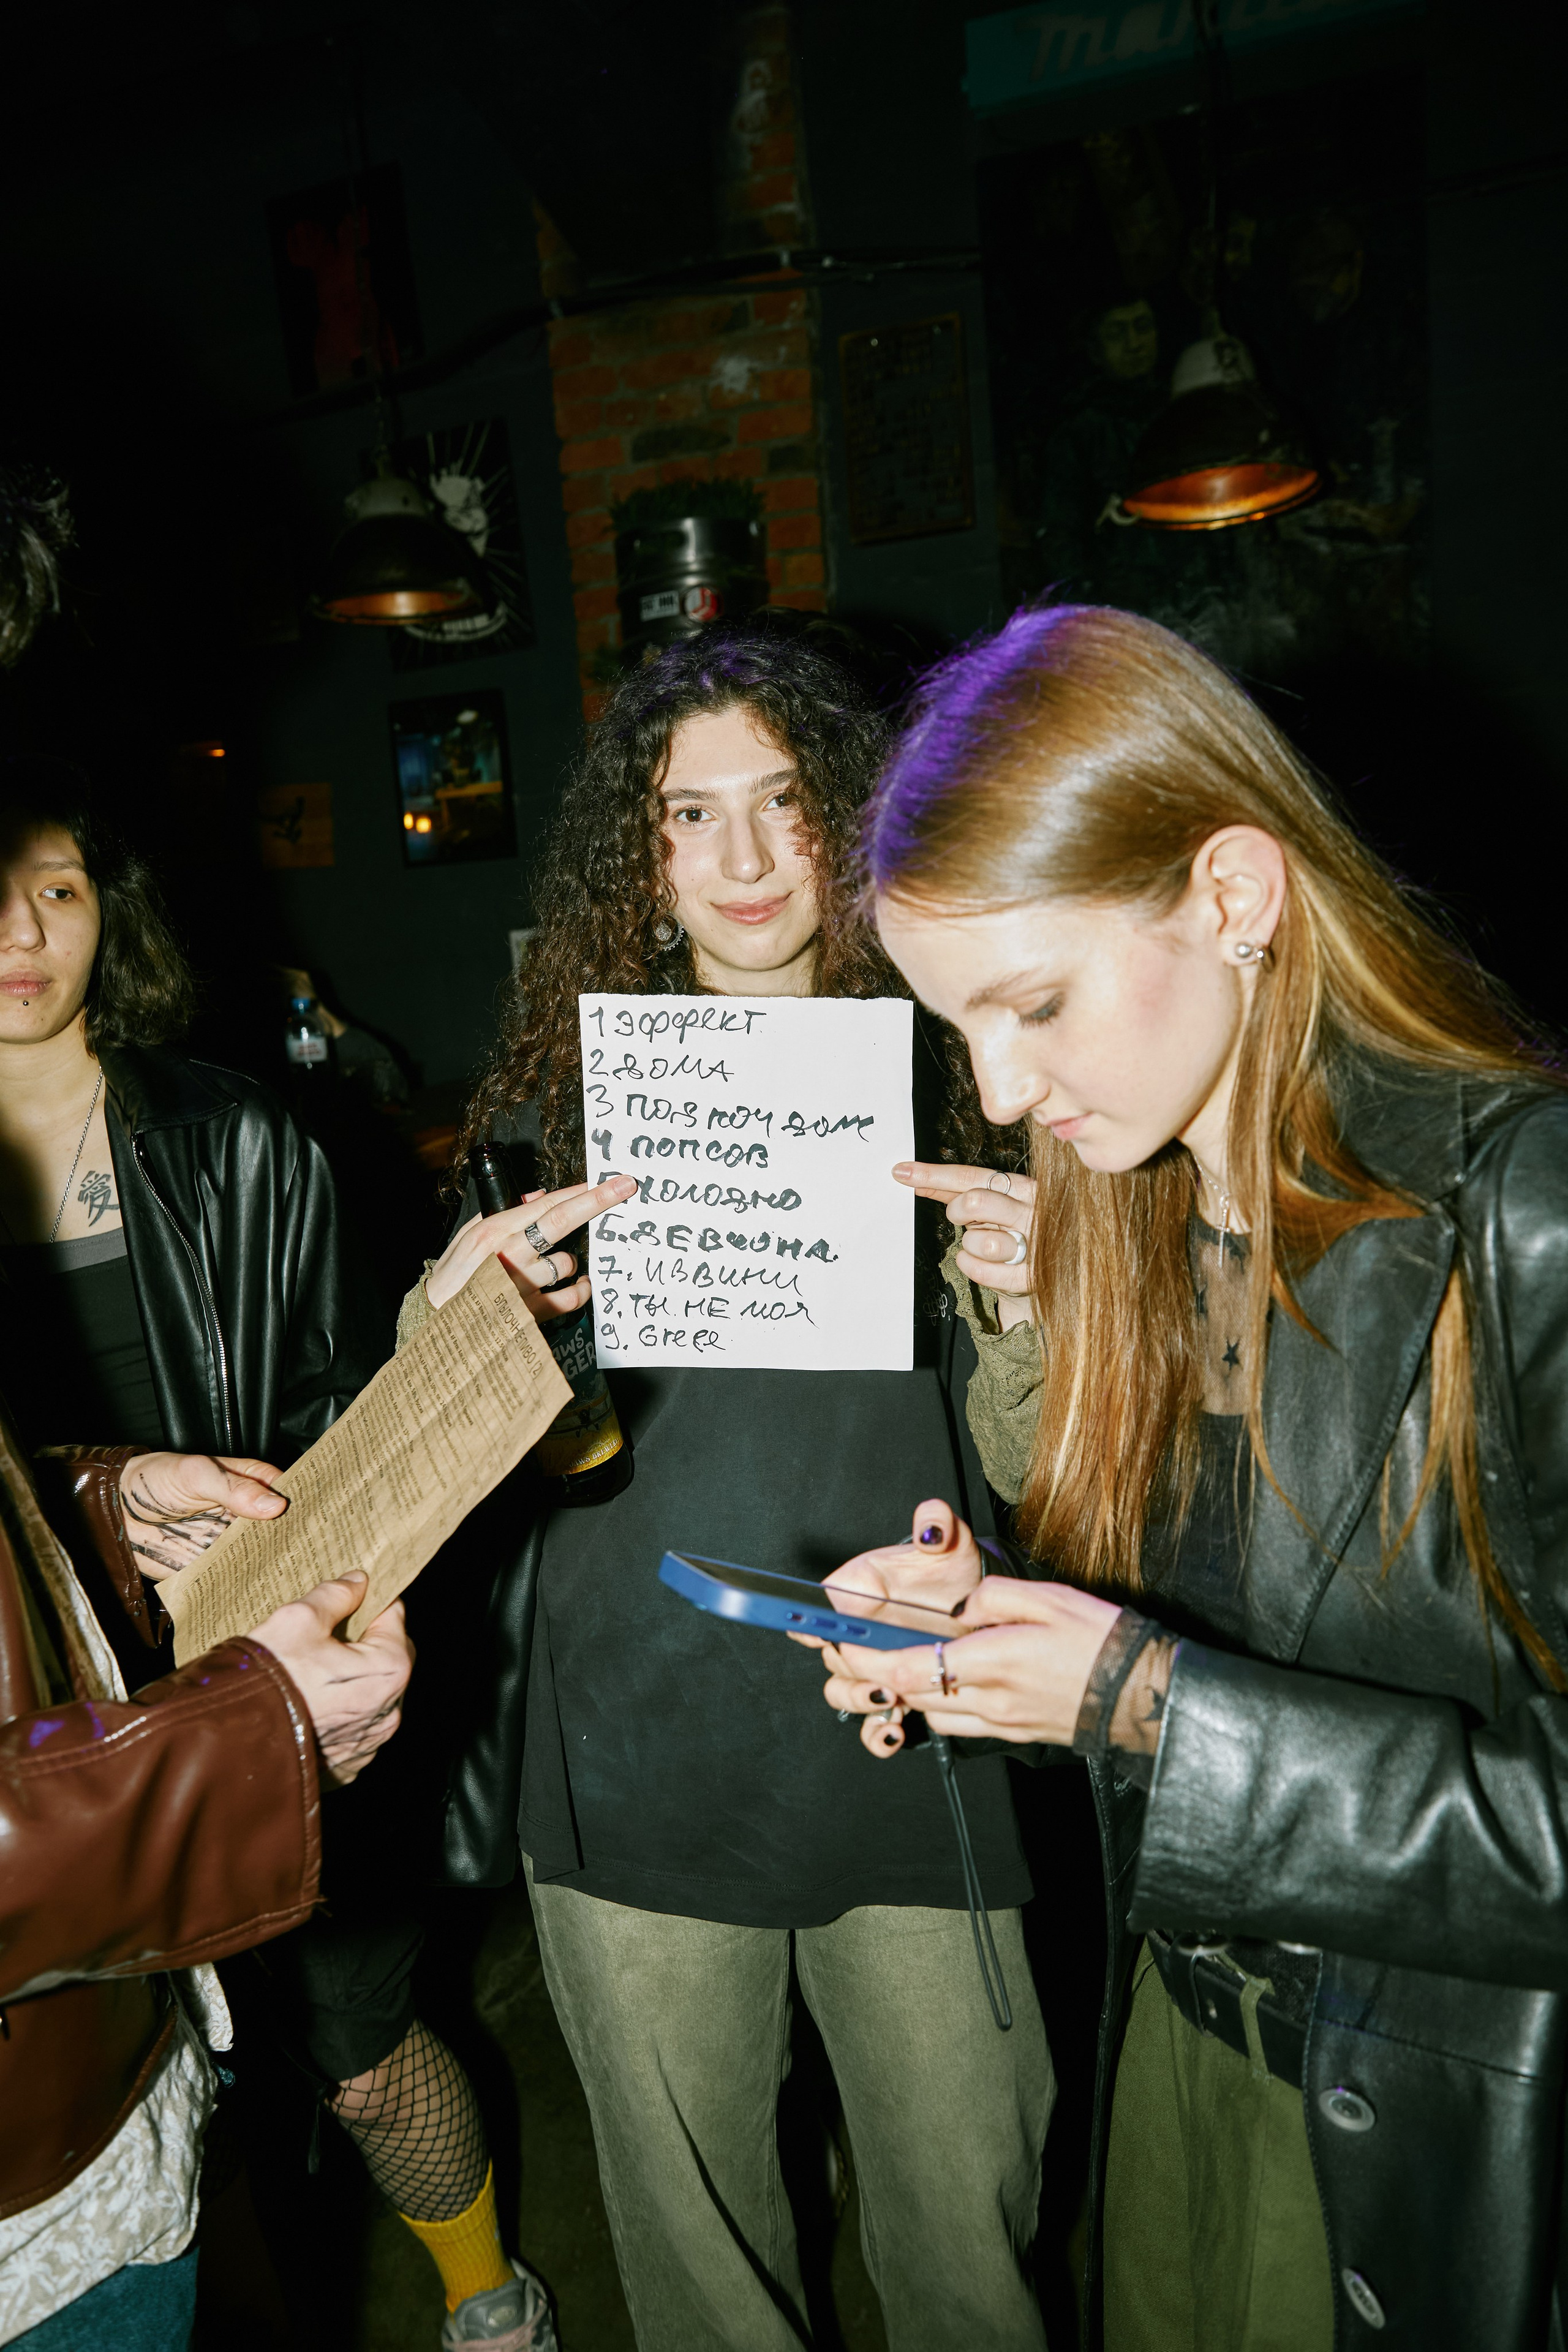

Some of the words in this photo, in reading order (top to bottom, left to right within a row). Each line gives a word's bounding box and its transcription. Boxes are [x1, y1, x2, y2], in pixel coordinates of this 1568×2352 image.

[589, 1006, 604, 1037] 1
[589, 1049, 609, 1076] 2
[586, 1084, 614, 1118] 3
[591, 1128, 613, 1161] 4
[551, 1327, 584, 1361] AWS
[562, 1340, 597, 1381] GER
[529, 1360, 545, 1380] (2)
